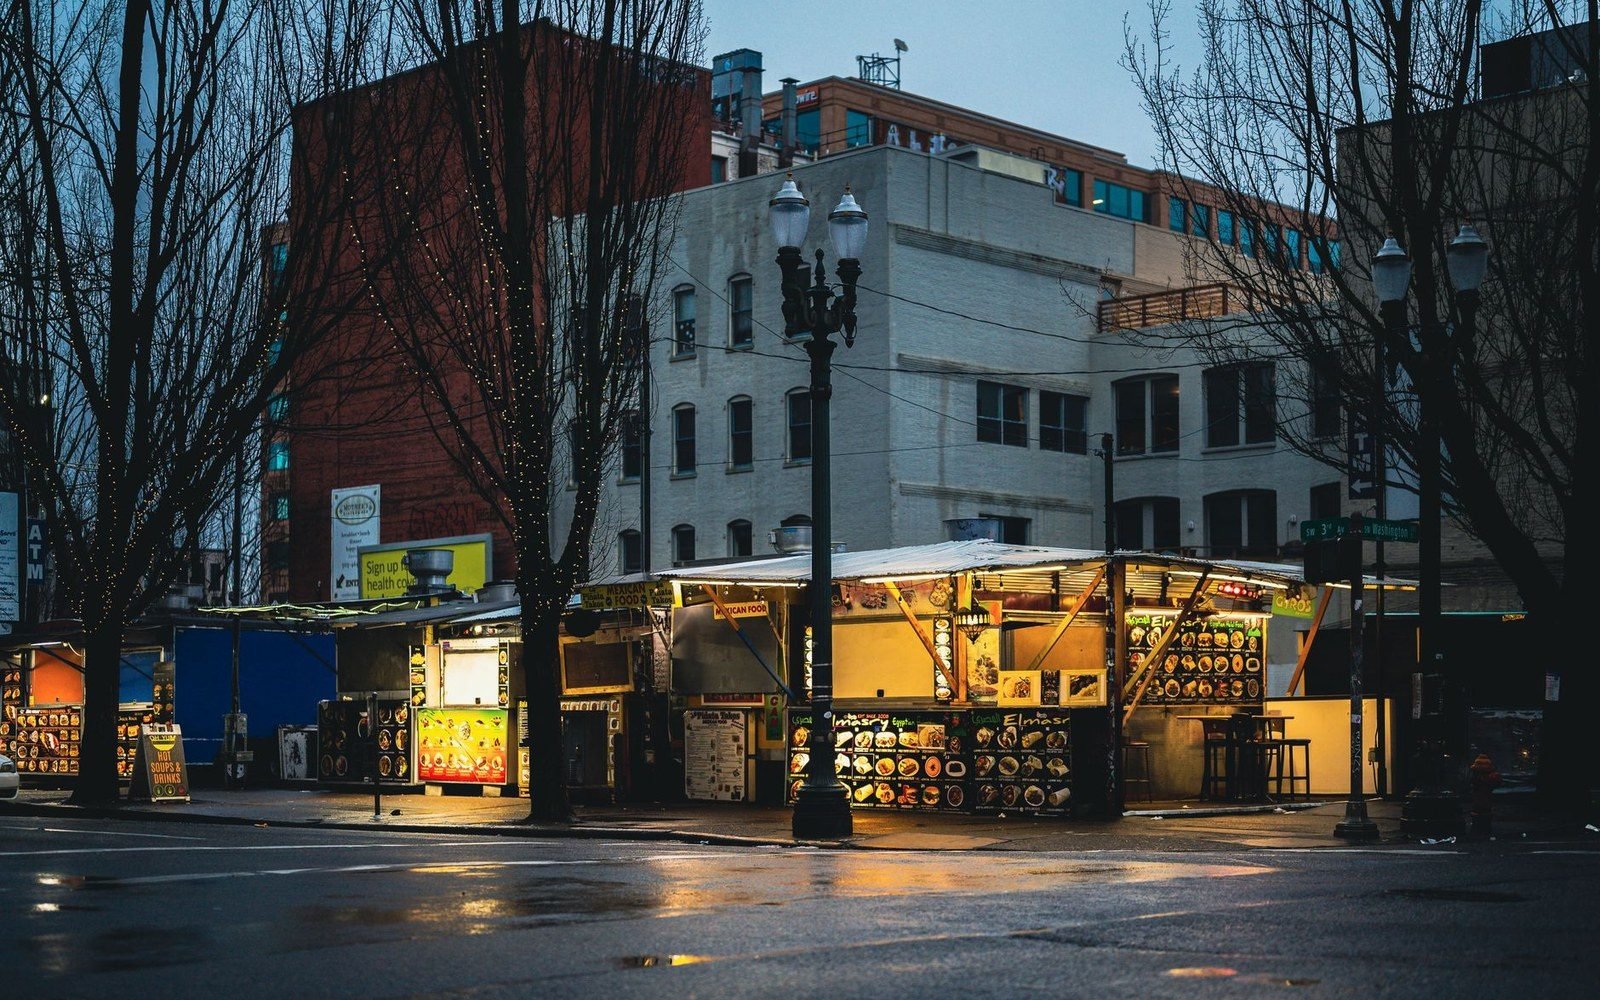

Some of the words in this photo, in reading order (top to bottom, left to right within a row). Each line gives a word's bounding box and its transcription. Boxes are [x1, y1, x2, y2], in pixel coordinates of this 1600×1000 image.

[1306, 528, 1315, 537] SW
[1372, 523, 1408, 540] Washington
[27, 524, 44, 580] ATM
[366, 561, 385, 576] Sign
[387, 562, 398, 575] up
[366, 576, 394, 591] health
[607, 583, 645, 595] MEXICAN
[615, 595, 639, 605] FOOD
[1276, 596, 1312, 612] GYROS
[715, 605, 747, 616] MXICAN
[748, 605, 767, 613] FOOD
[832, 714, 889, 732] lmasry
[1003, 712, 1070, 727] Elmasr
[157, 751, 171, 761] HOT
[150, 762, 174, 773] SOUPS
[175, 761, 182, 772] &
[154, 772, 181, 784] DRINKS
